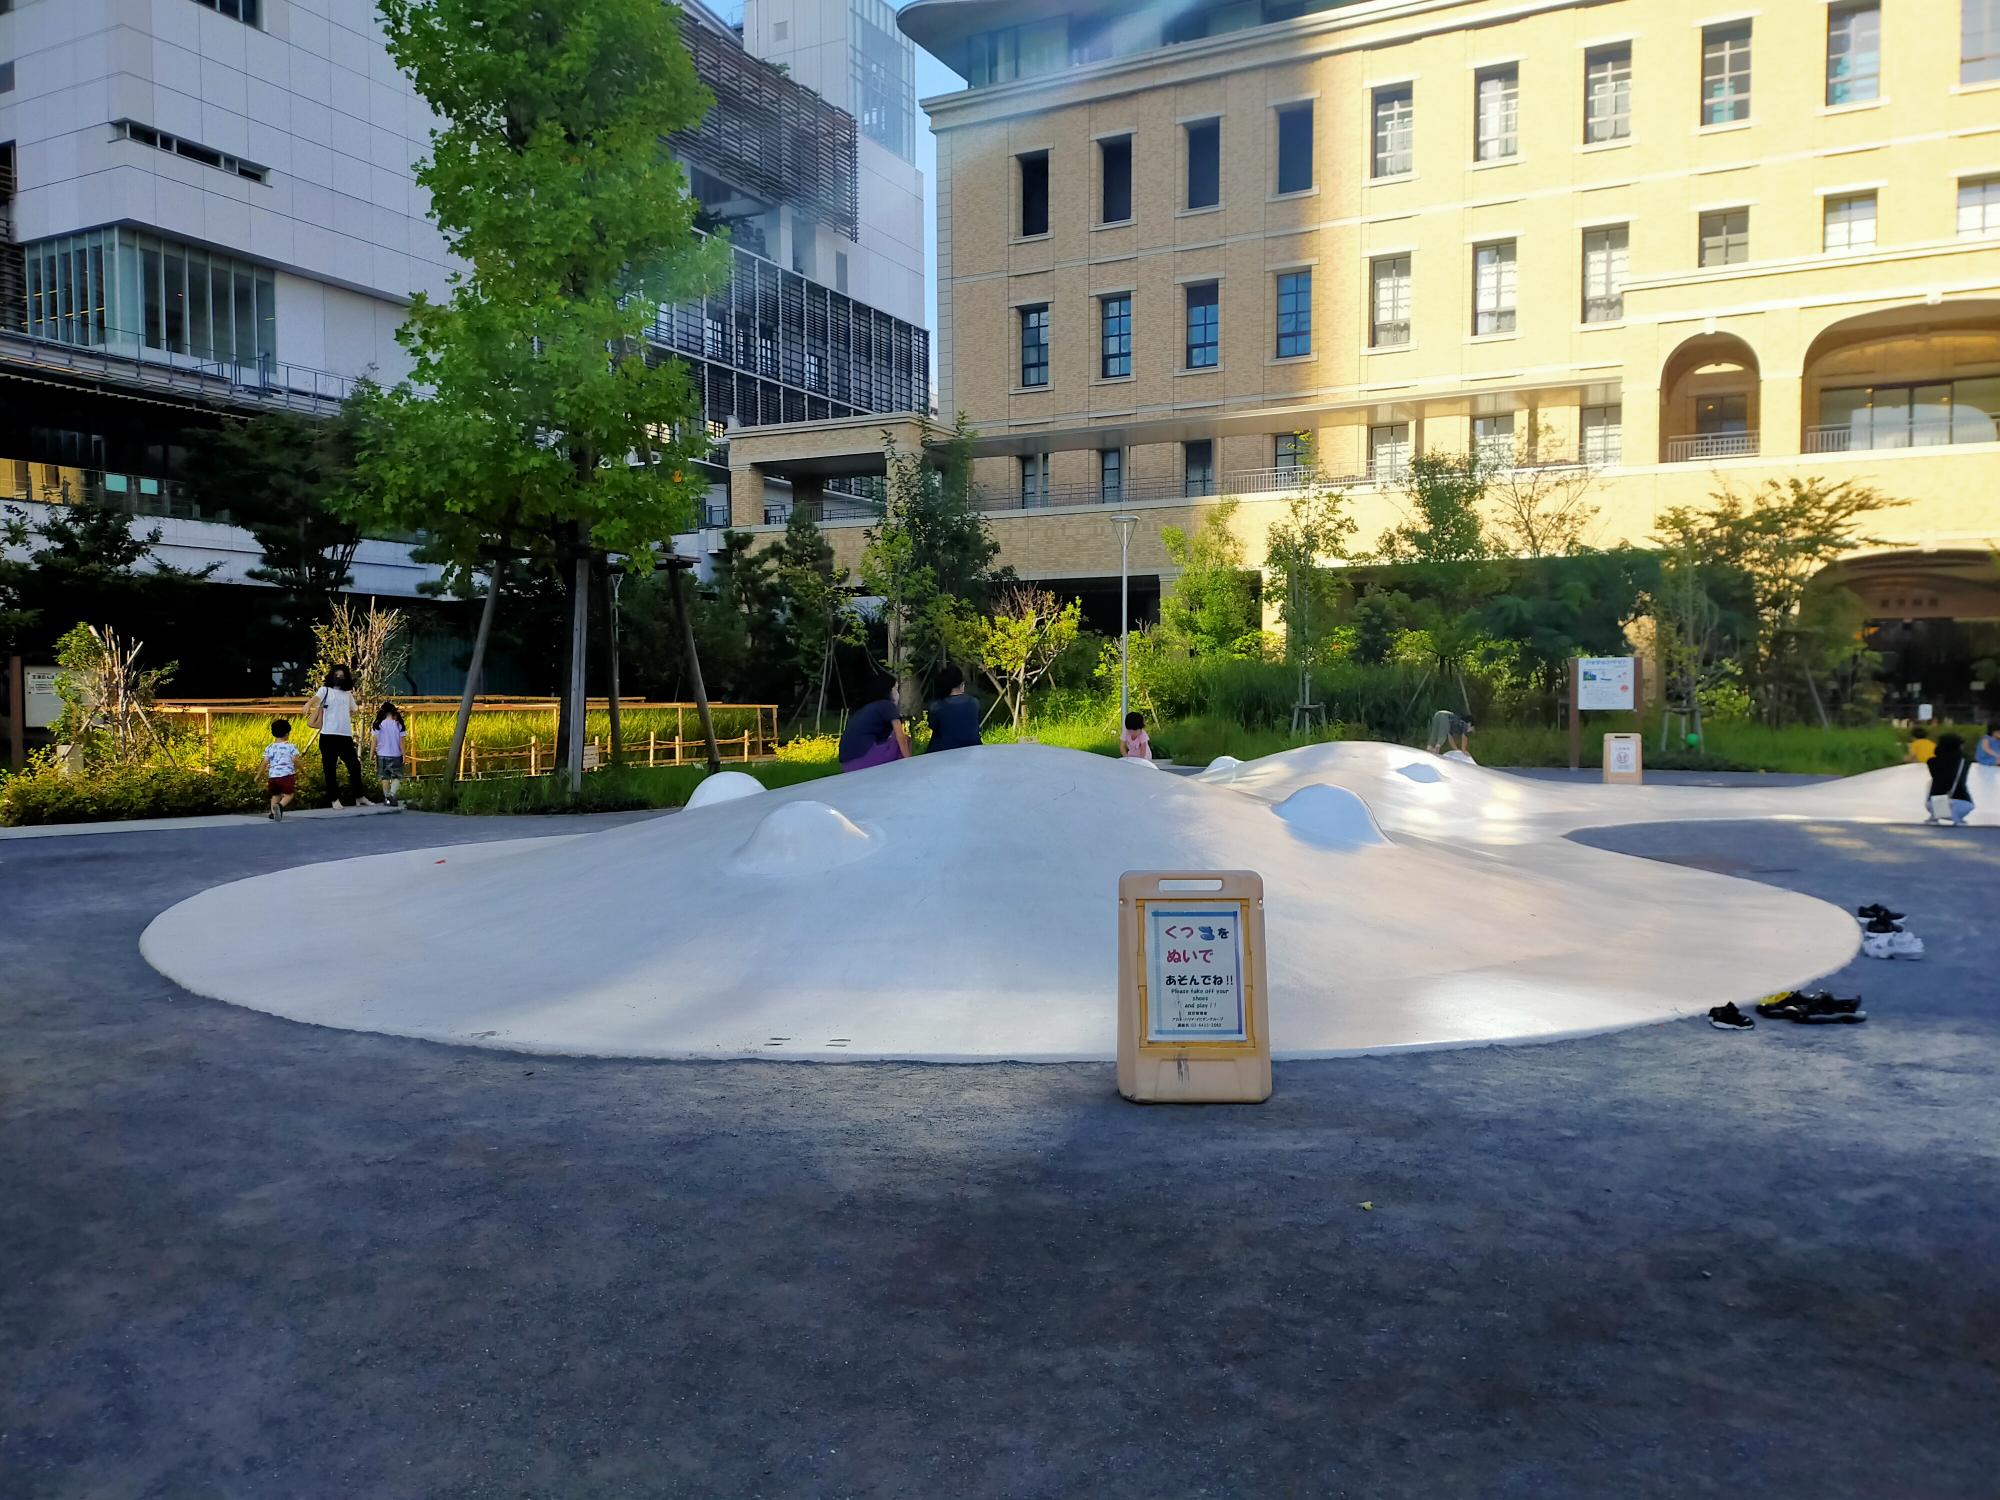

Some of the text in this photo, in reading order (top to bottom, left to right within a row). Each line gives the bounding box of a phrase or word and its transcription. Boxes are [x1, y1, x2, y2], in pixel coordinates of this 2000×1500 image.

[1165, 925, 1230, 940] くつ を
[1166, 949, 1214, 964] ぬいで
